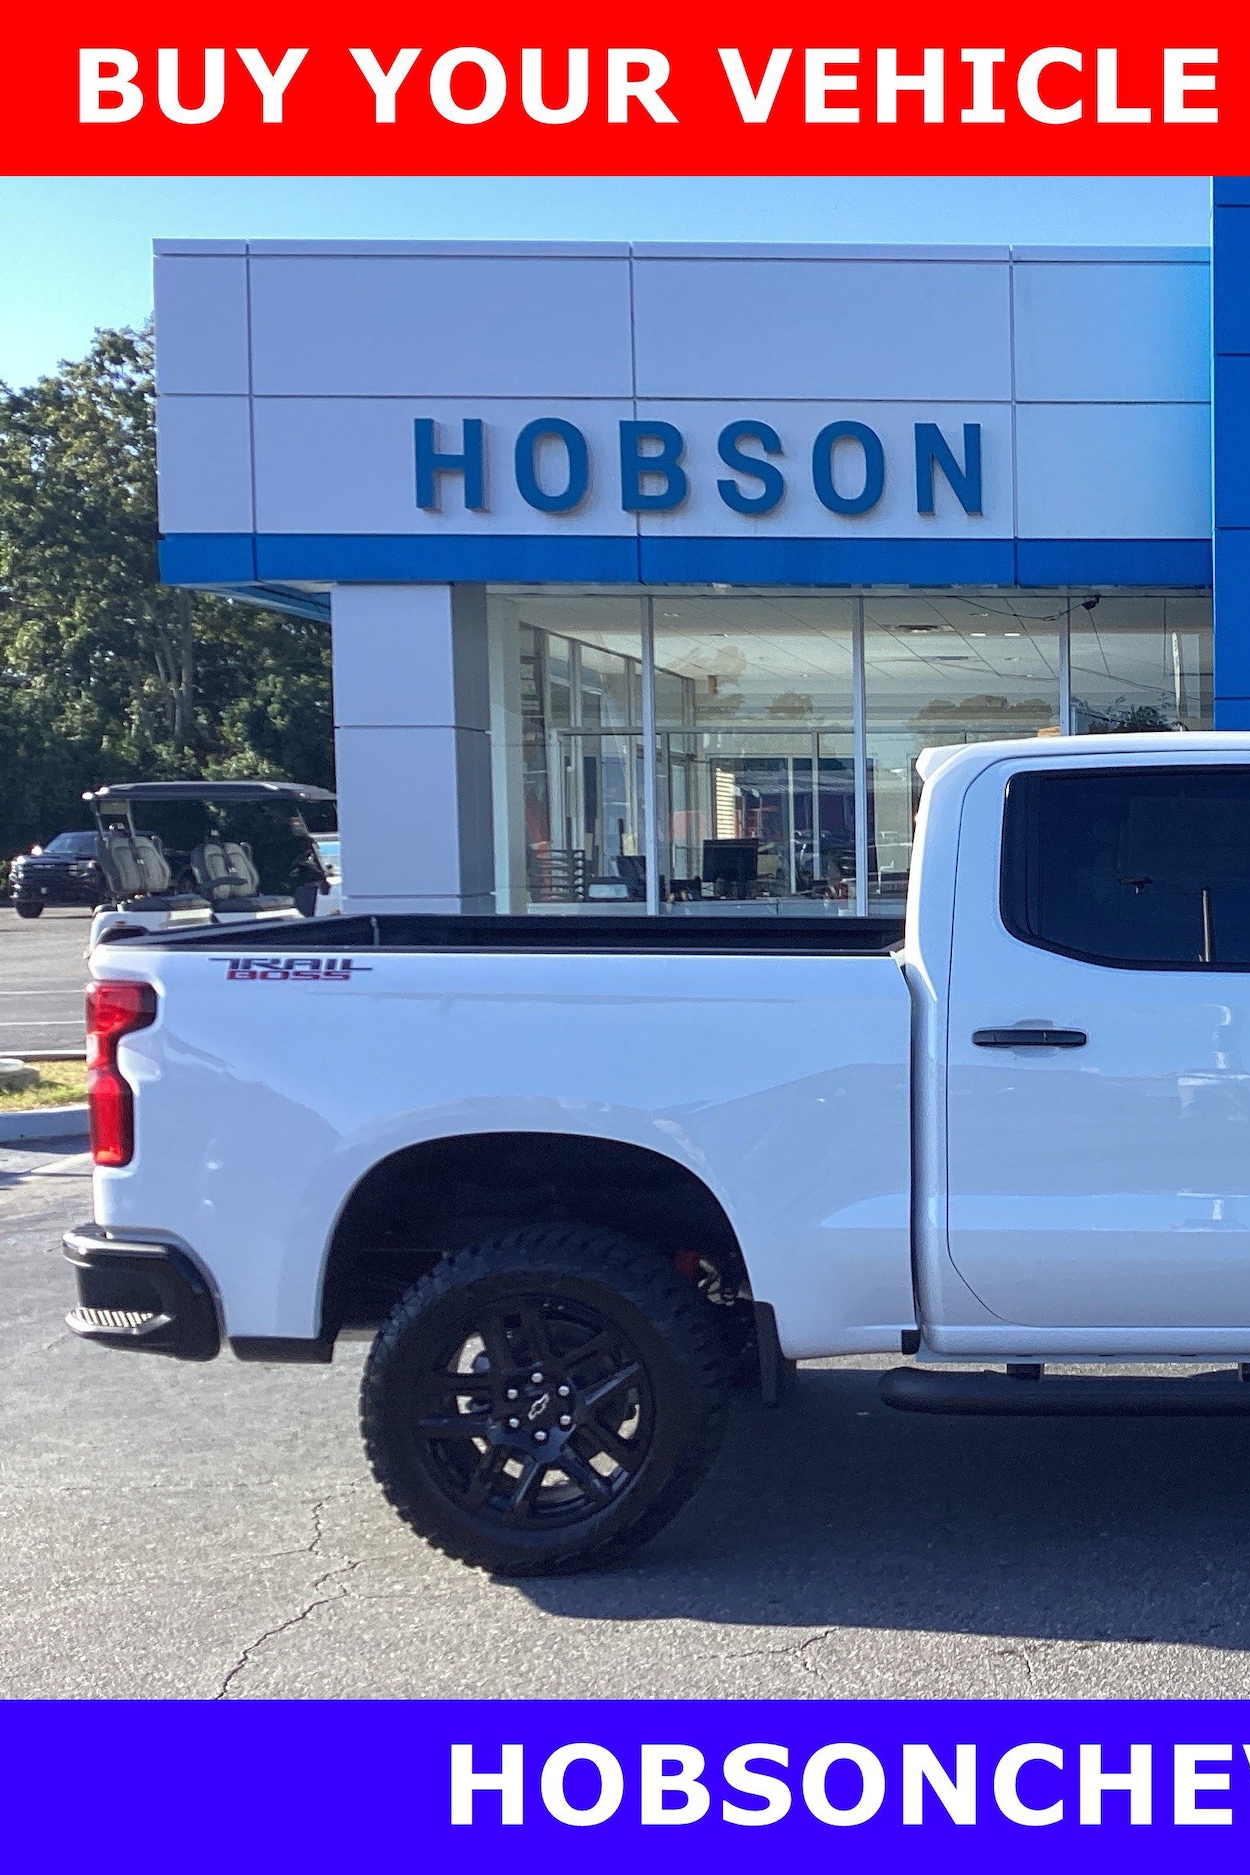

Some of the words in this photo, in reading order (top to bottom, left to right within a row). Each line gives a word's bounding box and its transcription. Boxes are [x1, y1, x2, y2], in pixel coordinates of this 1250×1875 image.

[413, 417, 984, 517] HOBSON
[209, 957, 373, 971] TRAIL
[226, 969, 352, 981] BOSS
